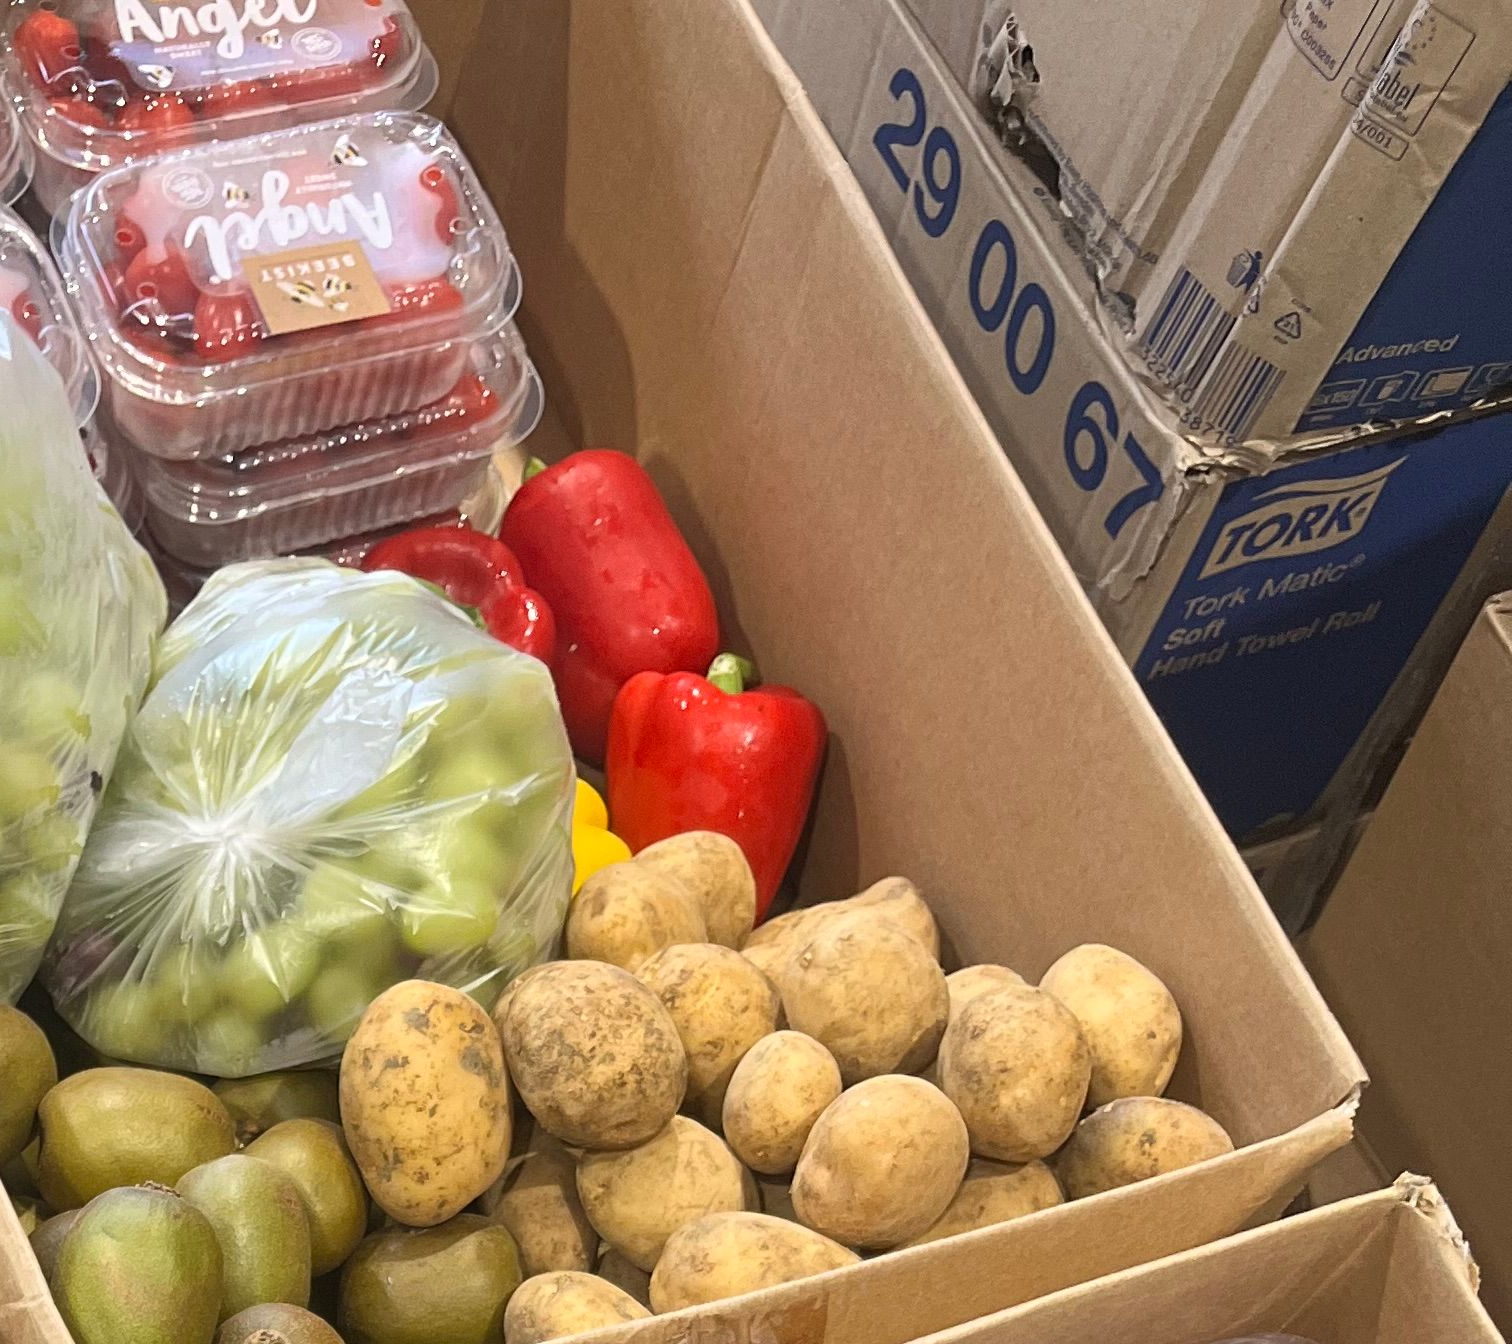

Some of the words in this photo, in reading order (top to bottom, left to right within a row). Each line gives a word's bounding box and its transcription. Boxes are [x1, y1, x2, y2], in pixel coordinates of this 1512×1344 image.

[185, 171, 390, 279] Angel
[259, 257, 353, 282] BEEKIST
[873, 68, 962, 238] 29
[969, 219, 1056, 395] 00
[1064, 381, 1165, 540] 67
[1335, 333, 1460, 365] Advanced
[1216, 491, 1375, 565] TORK
[1184, 586, 1251, 620] Tork
[1147, 642, 1230, 680] Hand
[1236, 618, 1321, 656] Towel
[1322, 600, 1384, 634] Roll
[1162, 617, 1225, 650] Soft
